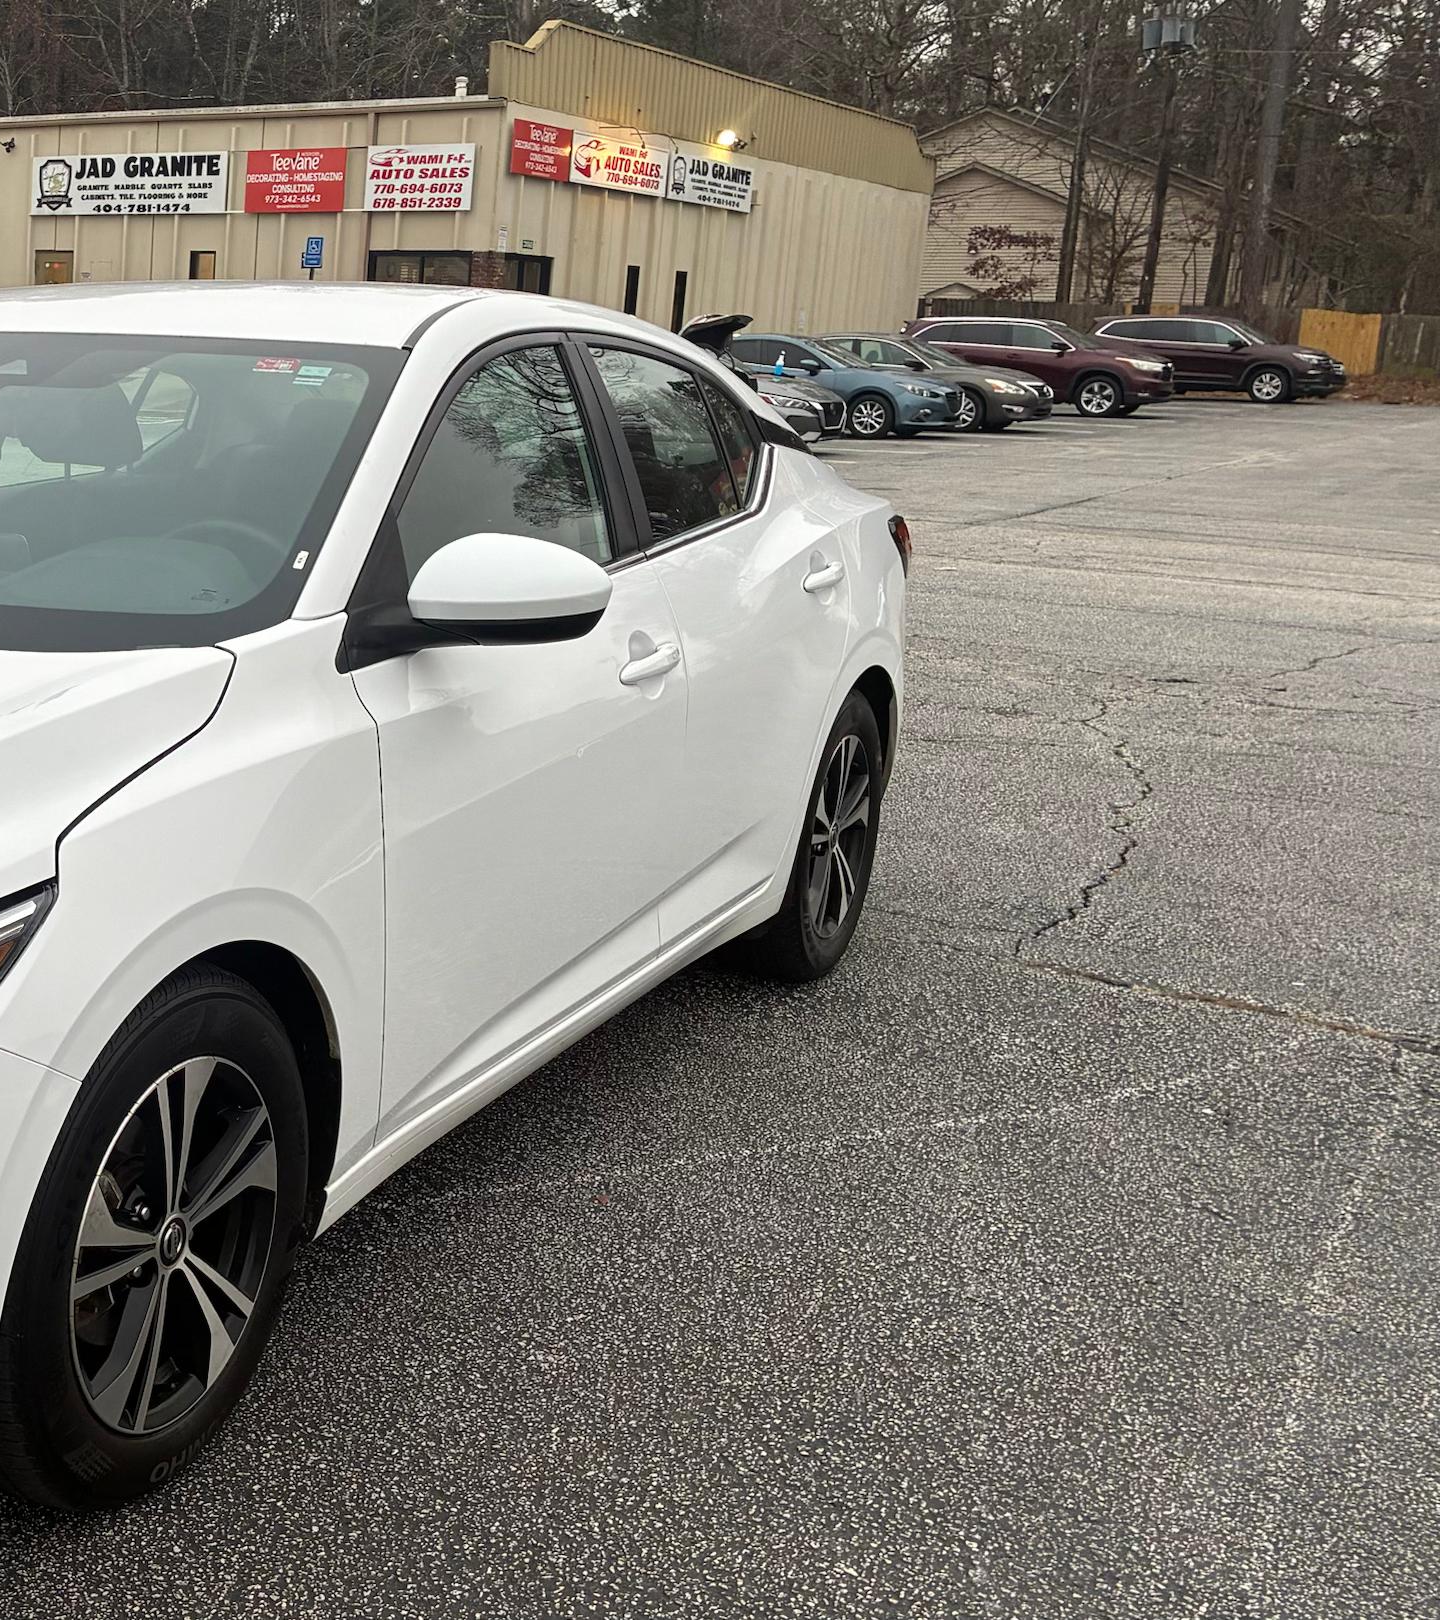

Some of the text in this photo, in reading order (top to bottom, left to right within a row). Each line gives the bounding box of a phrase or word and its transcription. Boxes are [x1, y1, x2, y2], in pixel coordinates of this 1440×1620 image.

[619, 146, 638, 158] WAMI
[406, 154, 444, 165] WAMI
[75, 155, 221, 180] JAD GRANITE
[604, 155, 661, 178] AUTO SALES
[689, 159, 752, 186] JAD GRANITE
[247, 173, 289, 183] DECORATING
[293, 172, 344, 182] HOMESTAGING
[369, 167, 471, 180] AUTO SALES
[606, 172, 660, 190] 770-694-6073
[272, 184, 315, 193] CONSULTING
[374, 182, 463, 194] 770-694-6073
[264, 194, 321, 203] 973-342-6543
[372, 197, 462, 209] 678-851-2339
[92, 203, 191, 213] 404-781-1474
